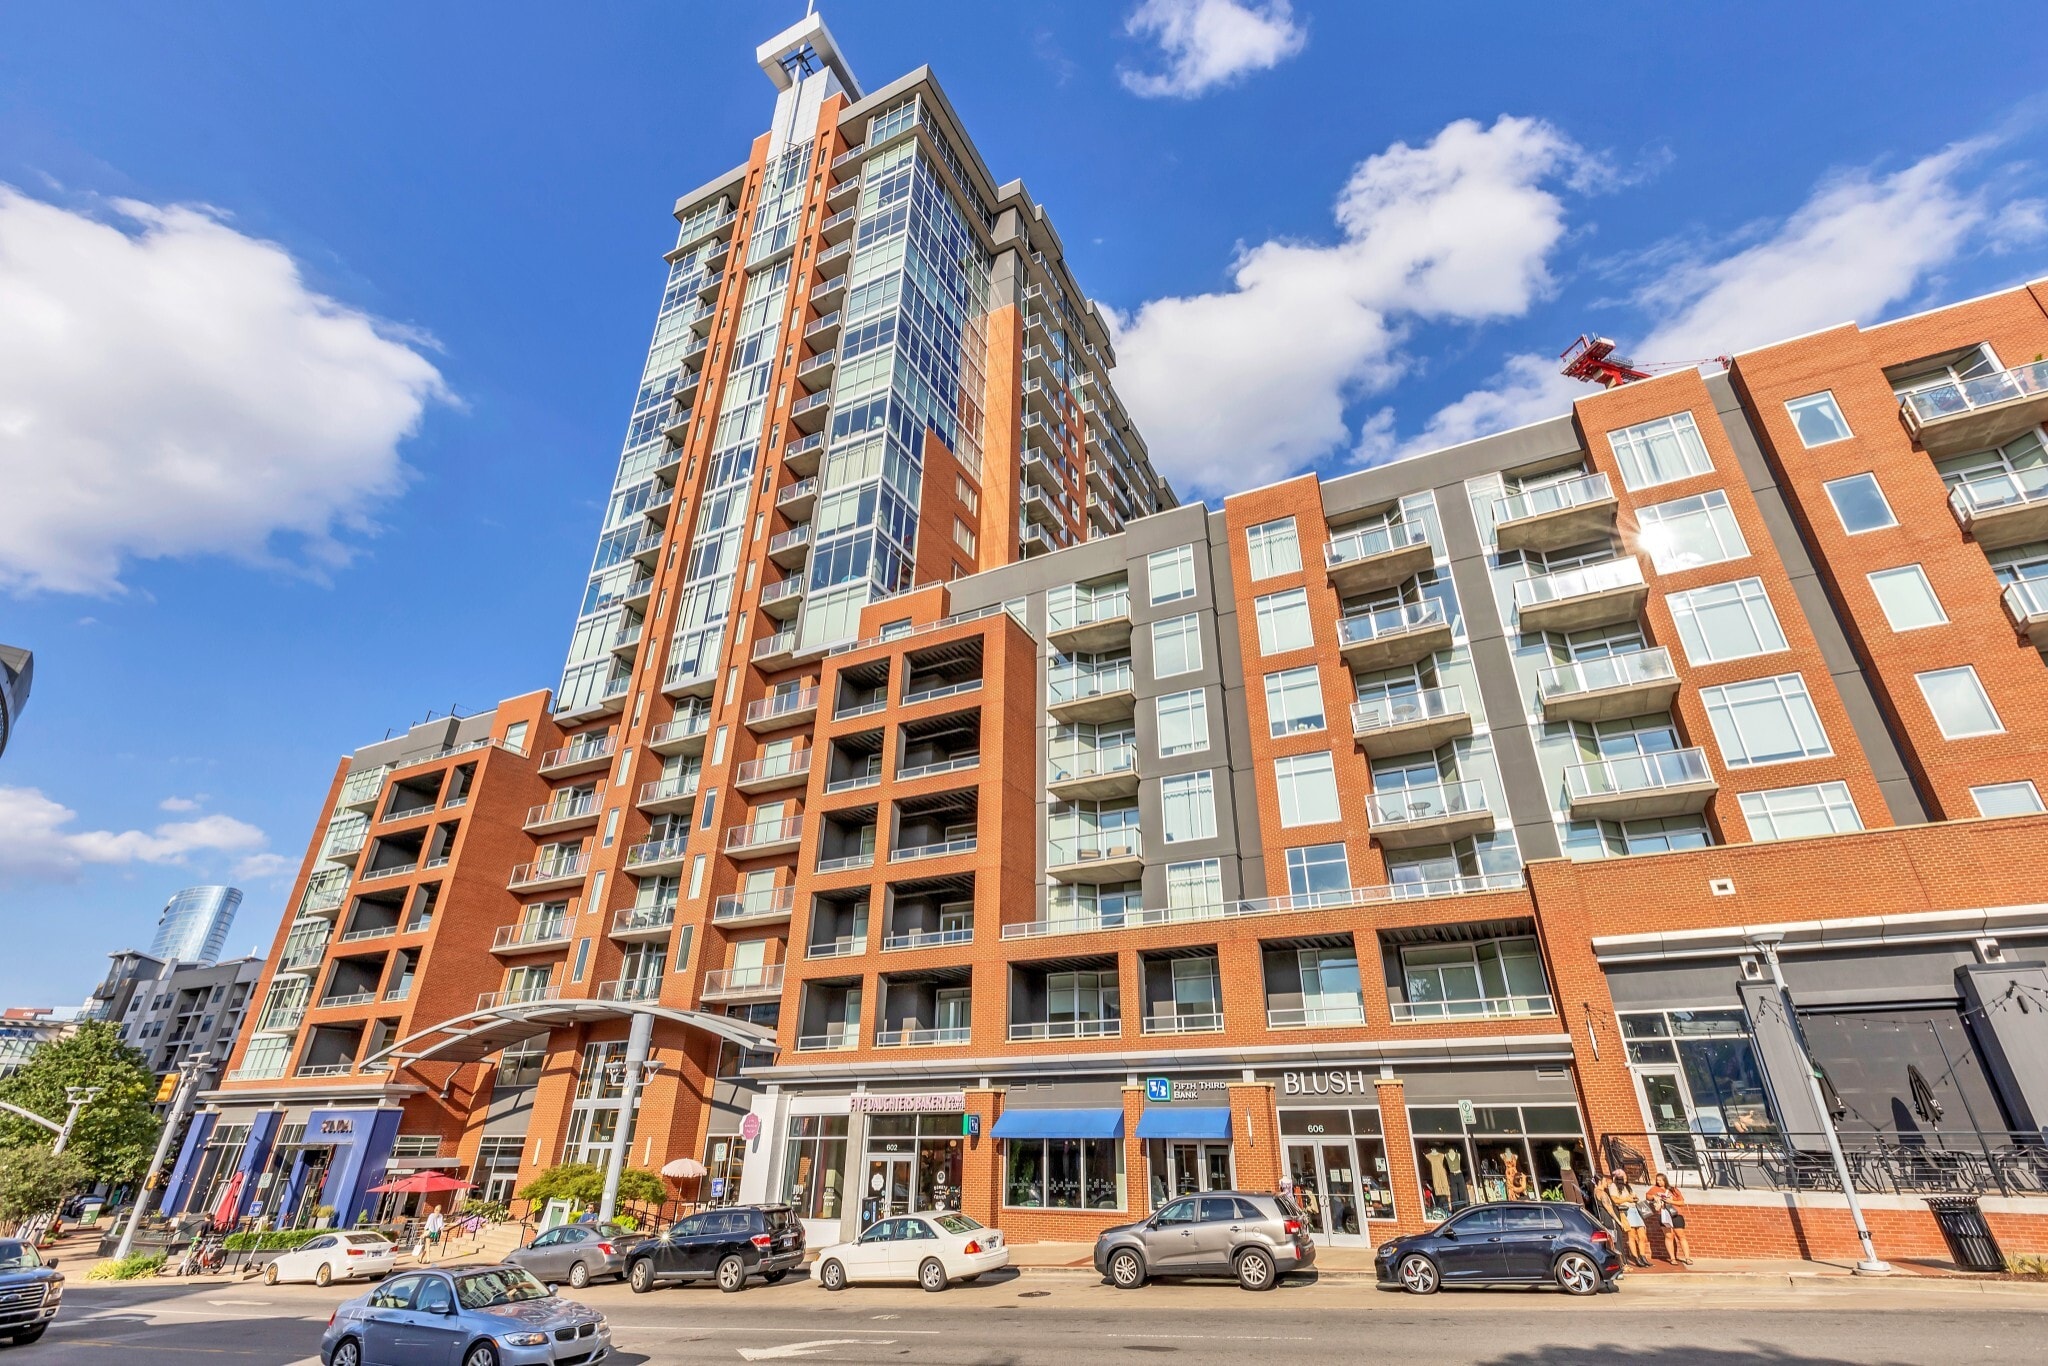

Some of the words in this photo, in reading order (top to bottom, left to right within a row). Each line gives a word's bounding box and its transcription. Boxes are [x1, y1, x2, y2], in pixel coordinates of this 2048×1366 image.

[1173, 1082, 1197, 1091] FIFTH
[1199, 1081, 1226, 1091] THIRD
[1283, 1070, 1365, 1095] BLUSH
[1173, 1091, 1198, 1100] BANK
[850, 1097, 867, 1112] FIVE
[868, 1096, 915, 1112] DAUGHTERS
[915, 1095, 947, 1111] BAKERY
[1307, 1124, 1324, 1133] 606
[886, 1143, 898, 1152] 602
